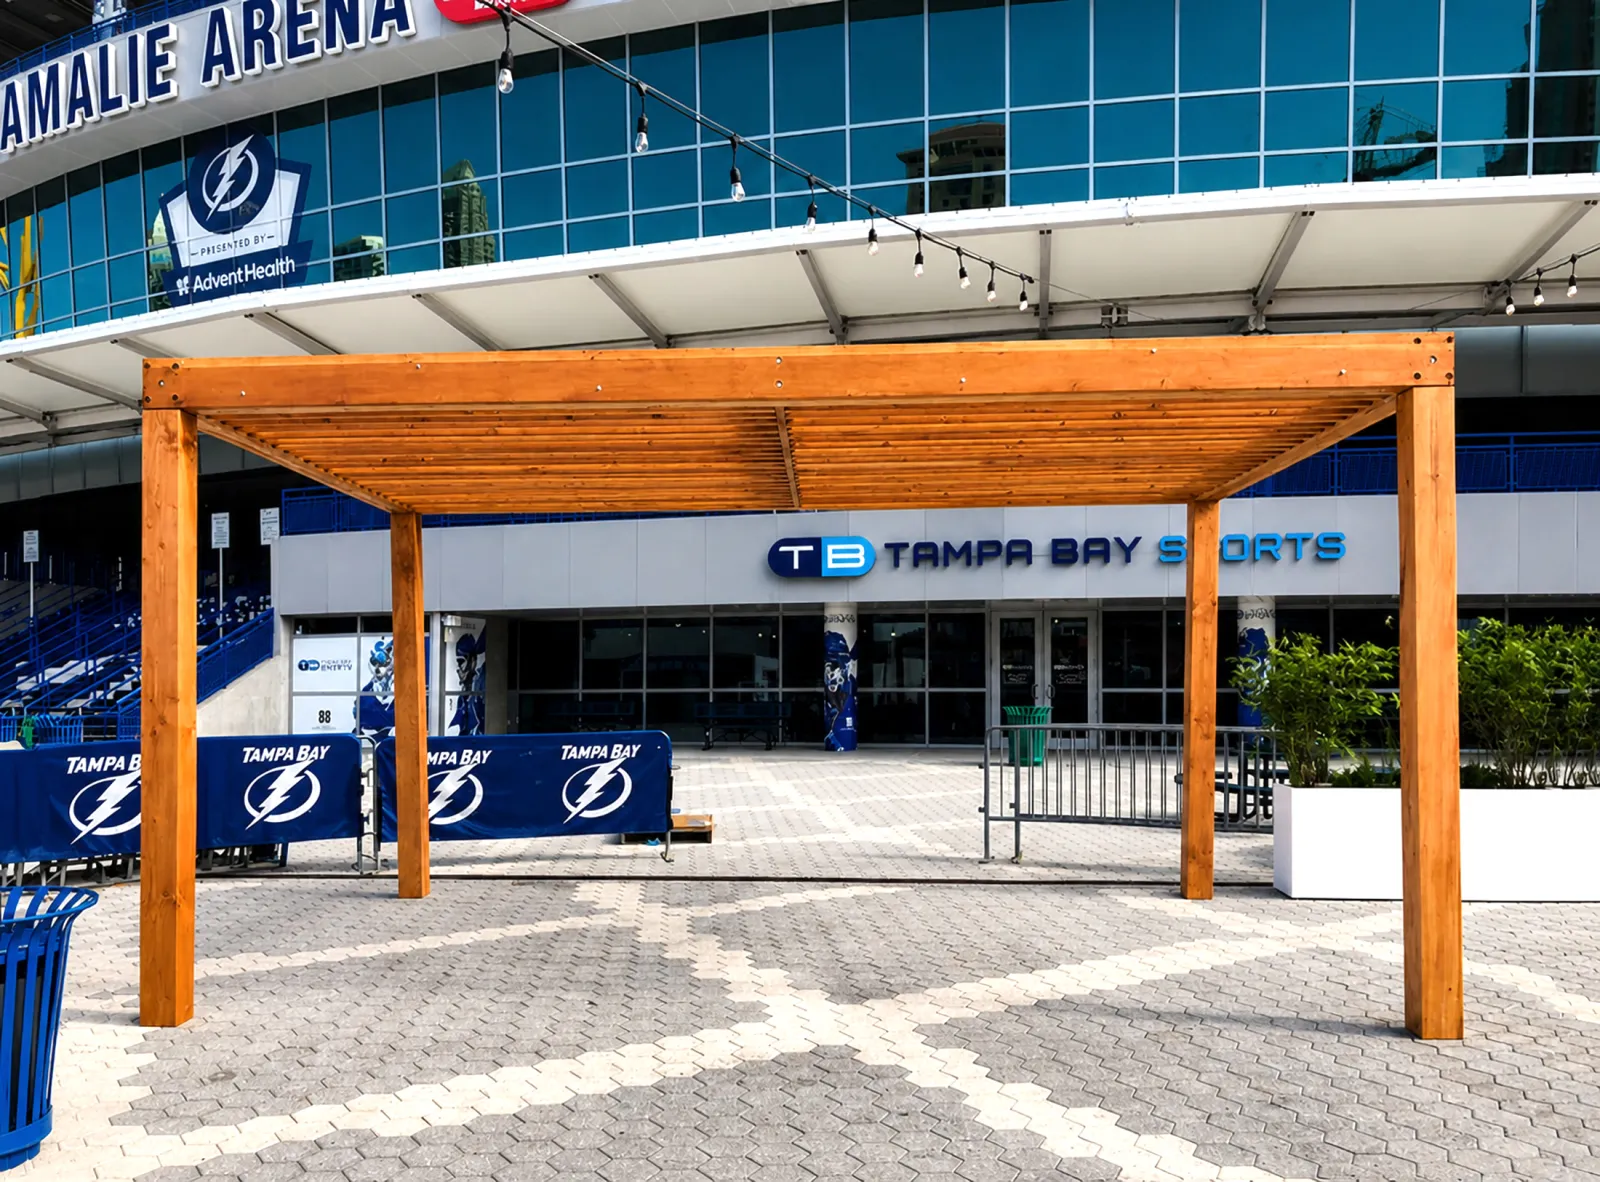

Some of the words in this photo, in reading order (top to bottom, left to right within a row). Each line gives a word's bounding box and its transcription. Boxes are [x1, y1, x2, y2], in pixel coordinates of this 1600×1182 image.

[0, 22, 178, 154] AMALIE
[200, 0, 417, 87] ARENA
[254, 233, 267, 245] BY
[193, 256, 296, 293] AdventHealth
[778, 543, 865, 570] TB
[884, 538, 1032, 568] TAMPA
[1051, 536, 1142, 564] BAY
[1159, 532, 1347, 563] SORTS
[318, 710, 331, 723] 88
[242, 747, 292, 763] TAMPA
[295, 745, 331, 761] BAY
[427, 752, 457, 766] MPA
[459, 749, 492, 766] BAY
[561, 745, 609, 760] TAMPA
[610, 743, 641, 760] BAY
[67, 756, 125, 774] TAMPA
